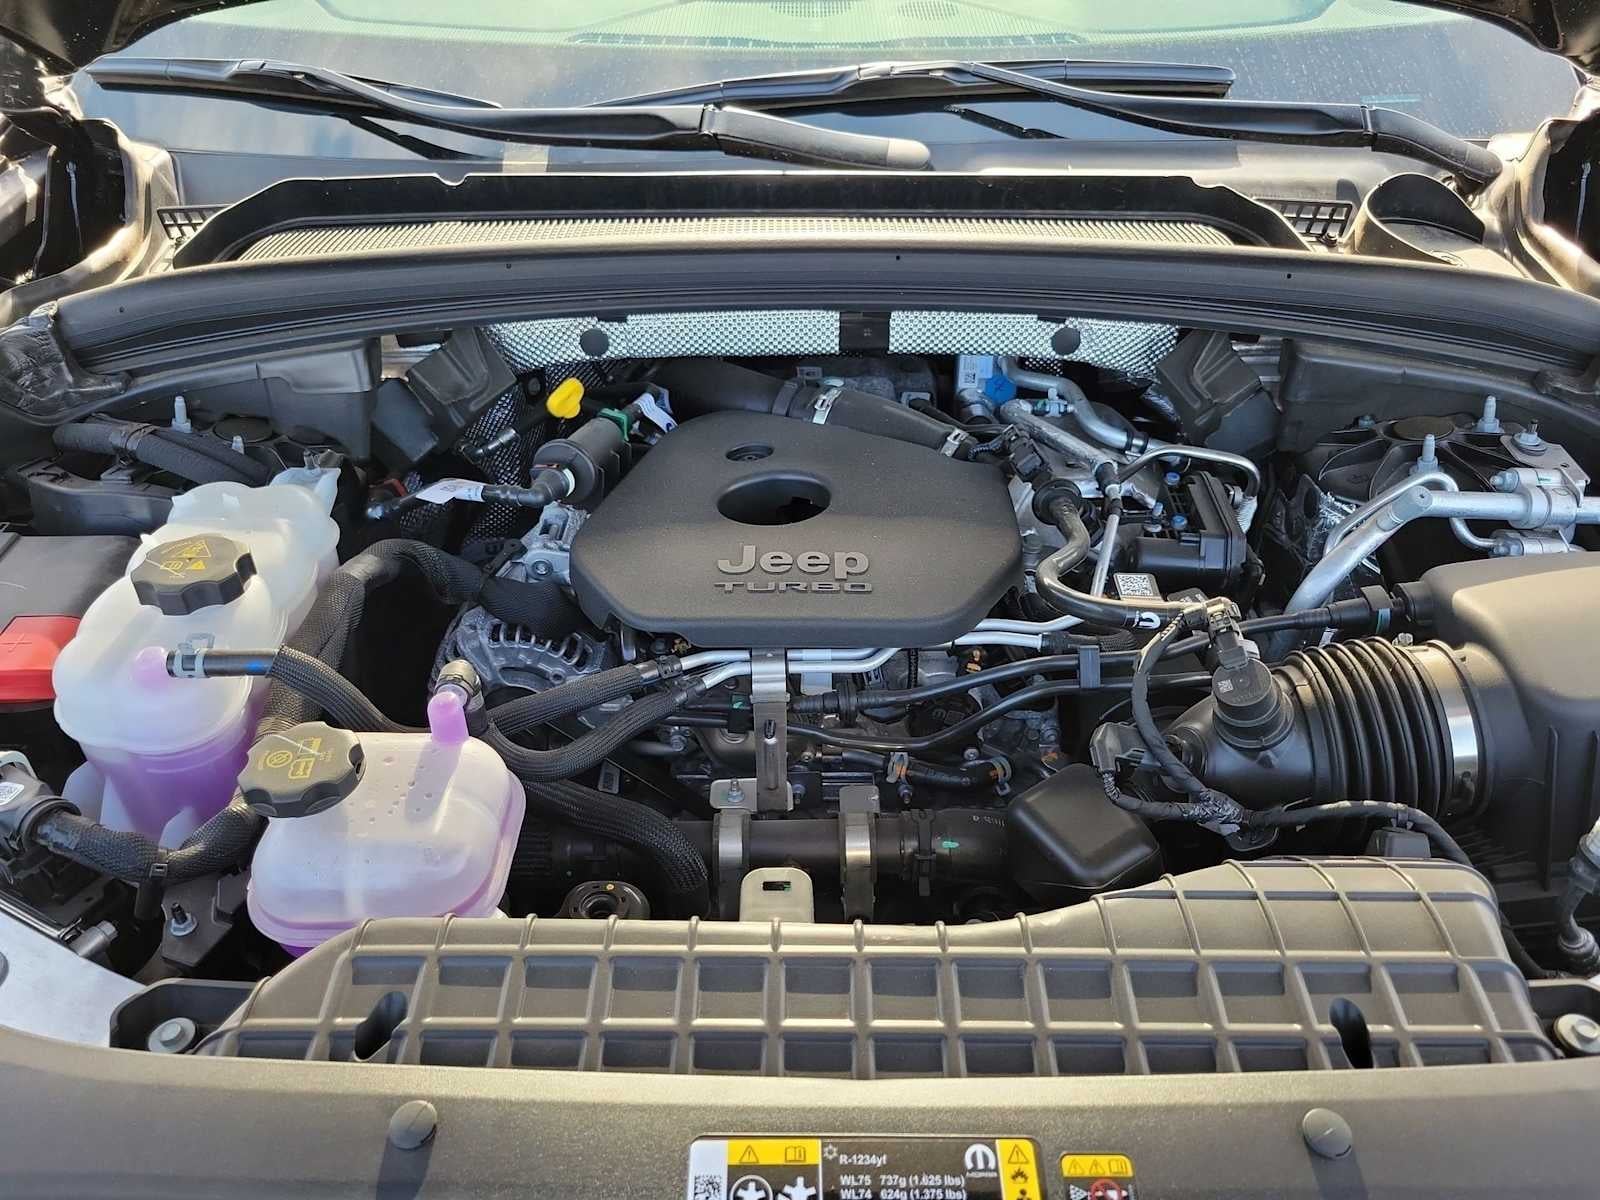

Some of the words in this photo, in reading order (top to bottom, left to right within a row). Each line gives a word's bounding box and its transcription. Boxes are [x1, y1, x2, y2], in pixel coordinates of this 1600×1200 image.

[718, 545, 869, 581] Jeep
[714, 582, 872, 593] TURBO
[839, 1154, 887, 1167] R-1234yf
[840, 1175, 872, 1186] WL75
[880, 1175, 906, 1187] 737g
[944, 1174, 965, 1187] lbs)
[840, 1189, 873, 1200] WL74
[880, 1188, 907, 1200] 624g
[945, 1188, 967, 1200] lbs)
